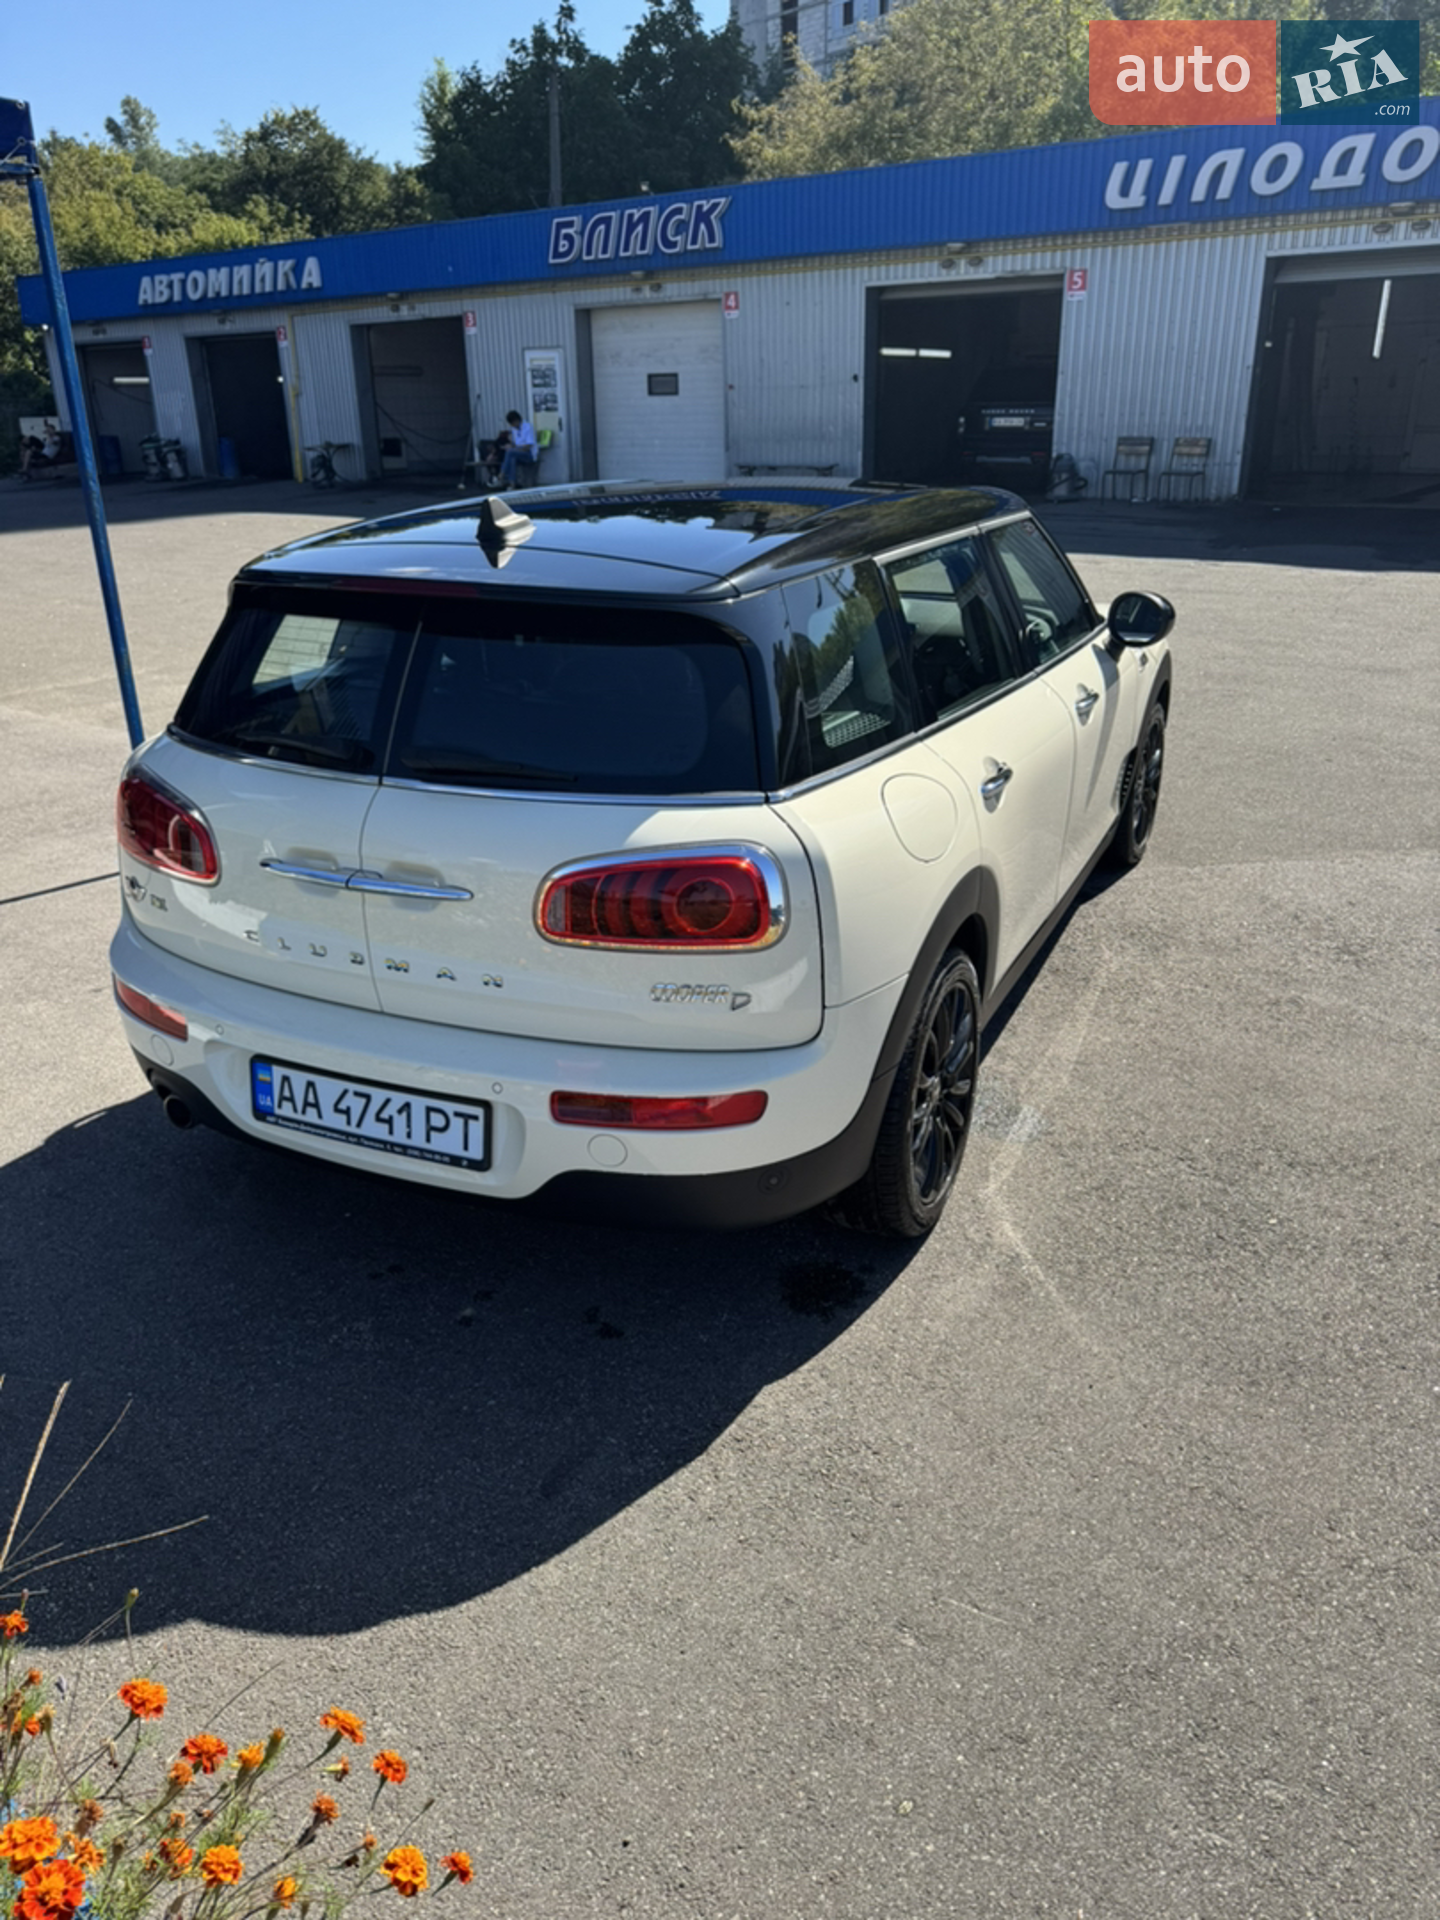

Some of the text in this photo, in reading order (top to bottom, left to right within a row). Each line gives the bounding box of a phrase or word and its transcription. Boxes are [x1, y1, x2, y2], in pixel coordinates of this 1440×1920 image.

[1104, 125, 1440, 211] ЦІЛОДО
[548, 196, 731, 264] БЛИСК
[138, 256, 322, 306] АВТОМИЙКА
[1072, 271, 1083, 289] 5
[727, 294, 736, 309] 4
[649, 982, 752, 1011] COOPER D
[258, 1093, 273, 1107] UA
[277, 1074, 323, 1120] AA
[333, 1088, 412, 1140] 4741
[425, 1105, 480, 1152] PT
